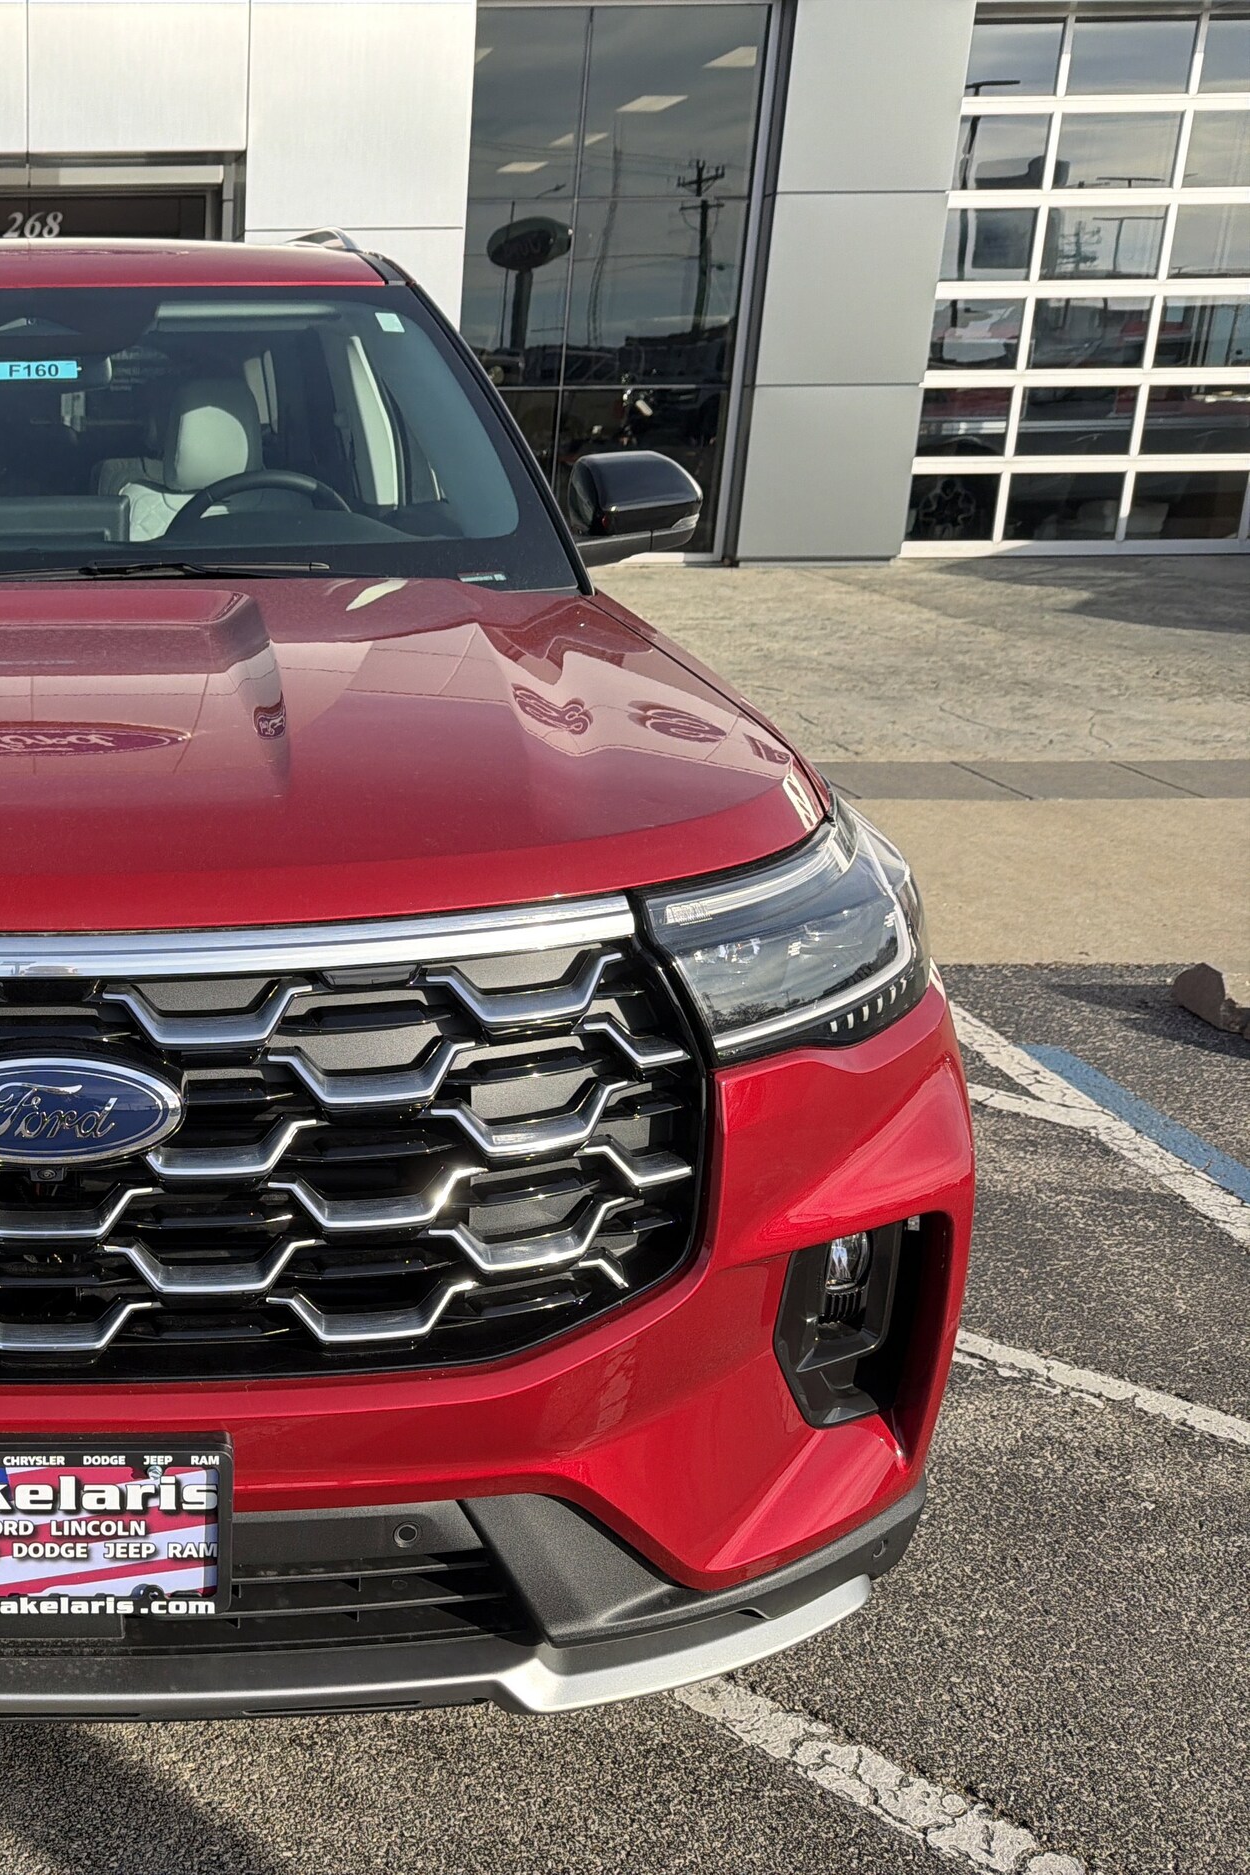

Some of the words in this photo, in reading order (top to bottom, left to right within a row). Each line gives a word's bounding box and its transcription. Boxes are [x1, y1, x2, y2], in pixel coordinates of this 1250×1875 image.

[2, 211, 63, 238] 268
[8, 364, 59, 378] F160
[3, 1455, 66, 1467] CHRYSLER
[83, 1455, 126, 1466] DODGE
[143, 1455, 173, 1466] JEEP
[190, 1455, 220, 1466] RAM
[50, 1519, 146, 1537] LINCOLN
[12, 1542, 89, 1559] DODGE
[103, 1542, 157, 1559] JEEP
[167, 1541, 218, 1559] RAM
